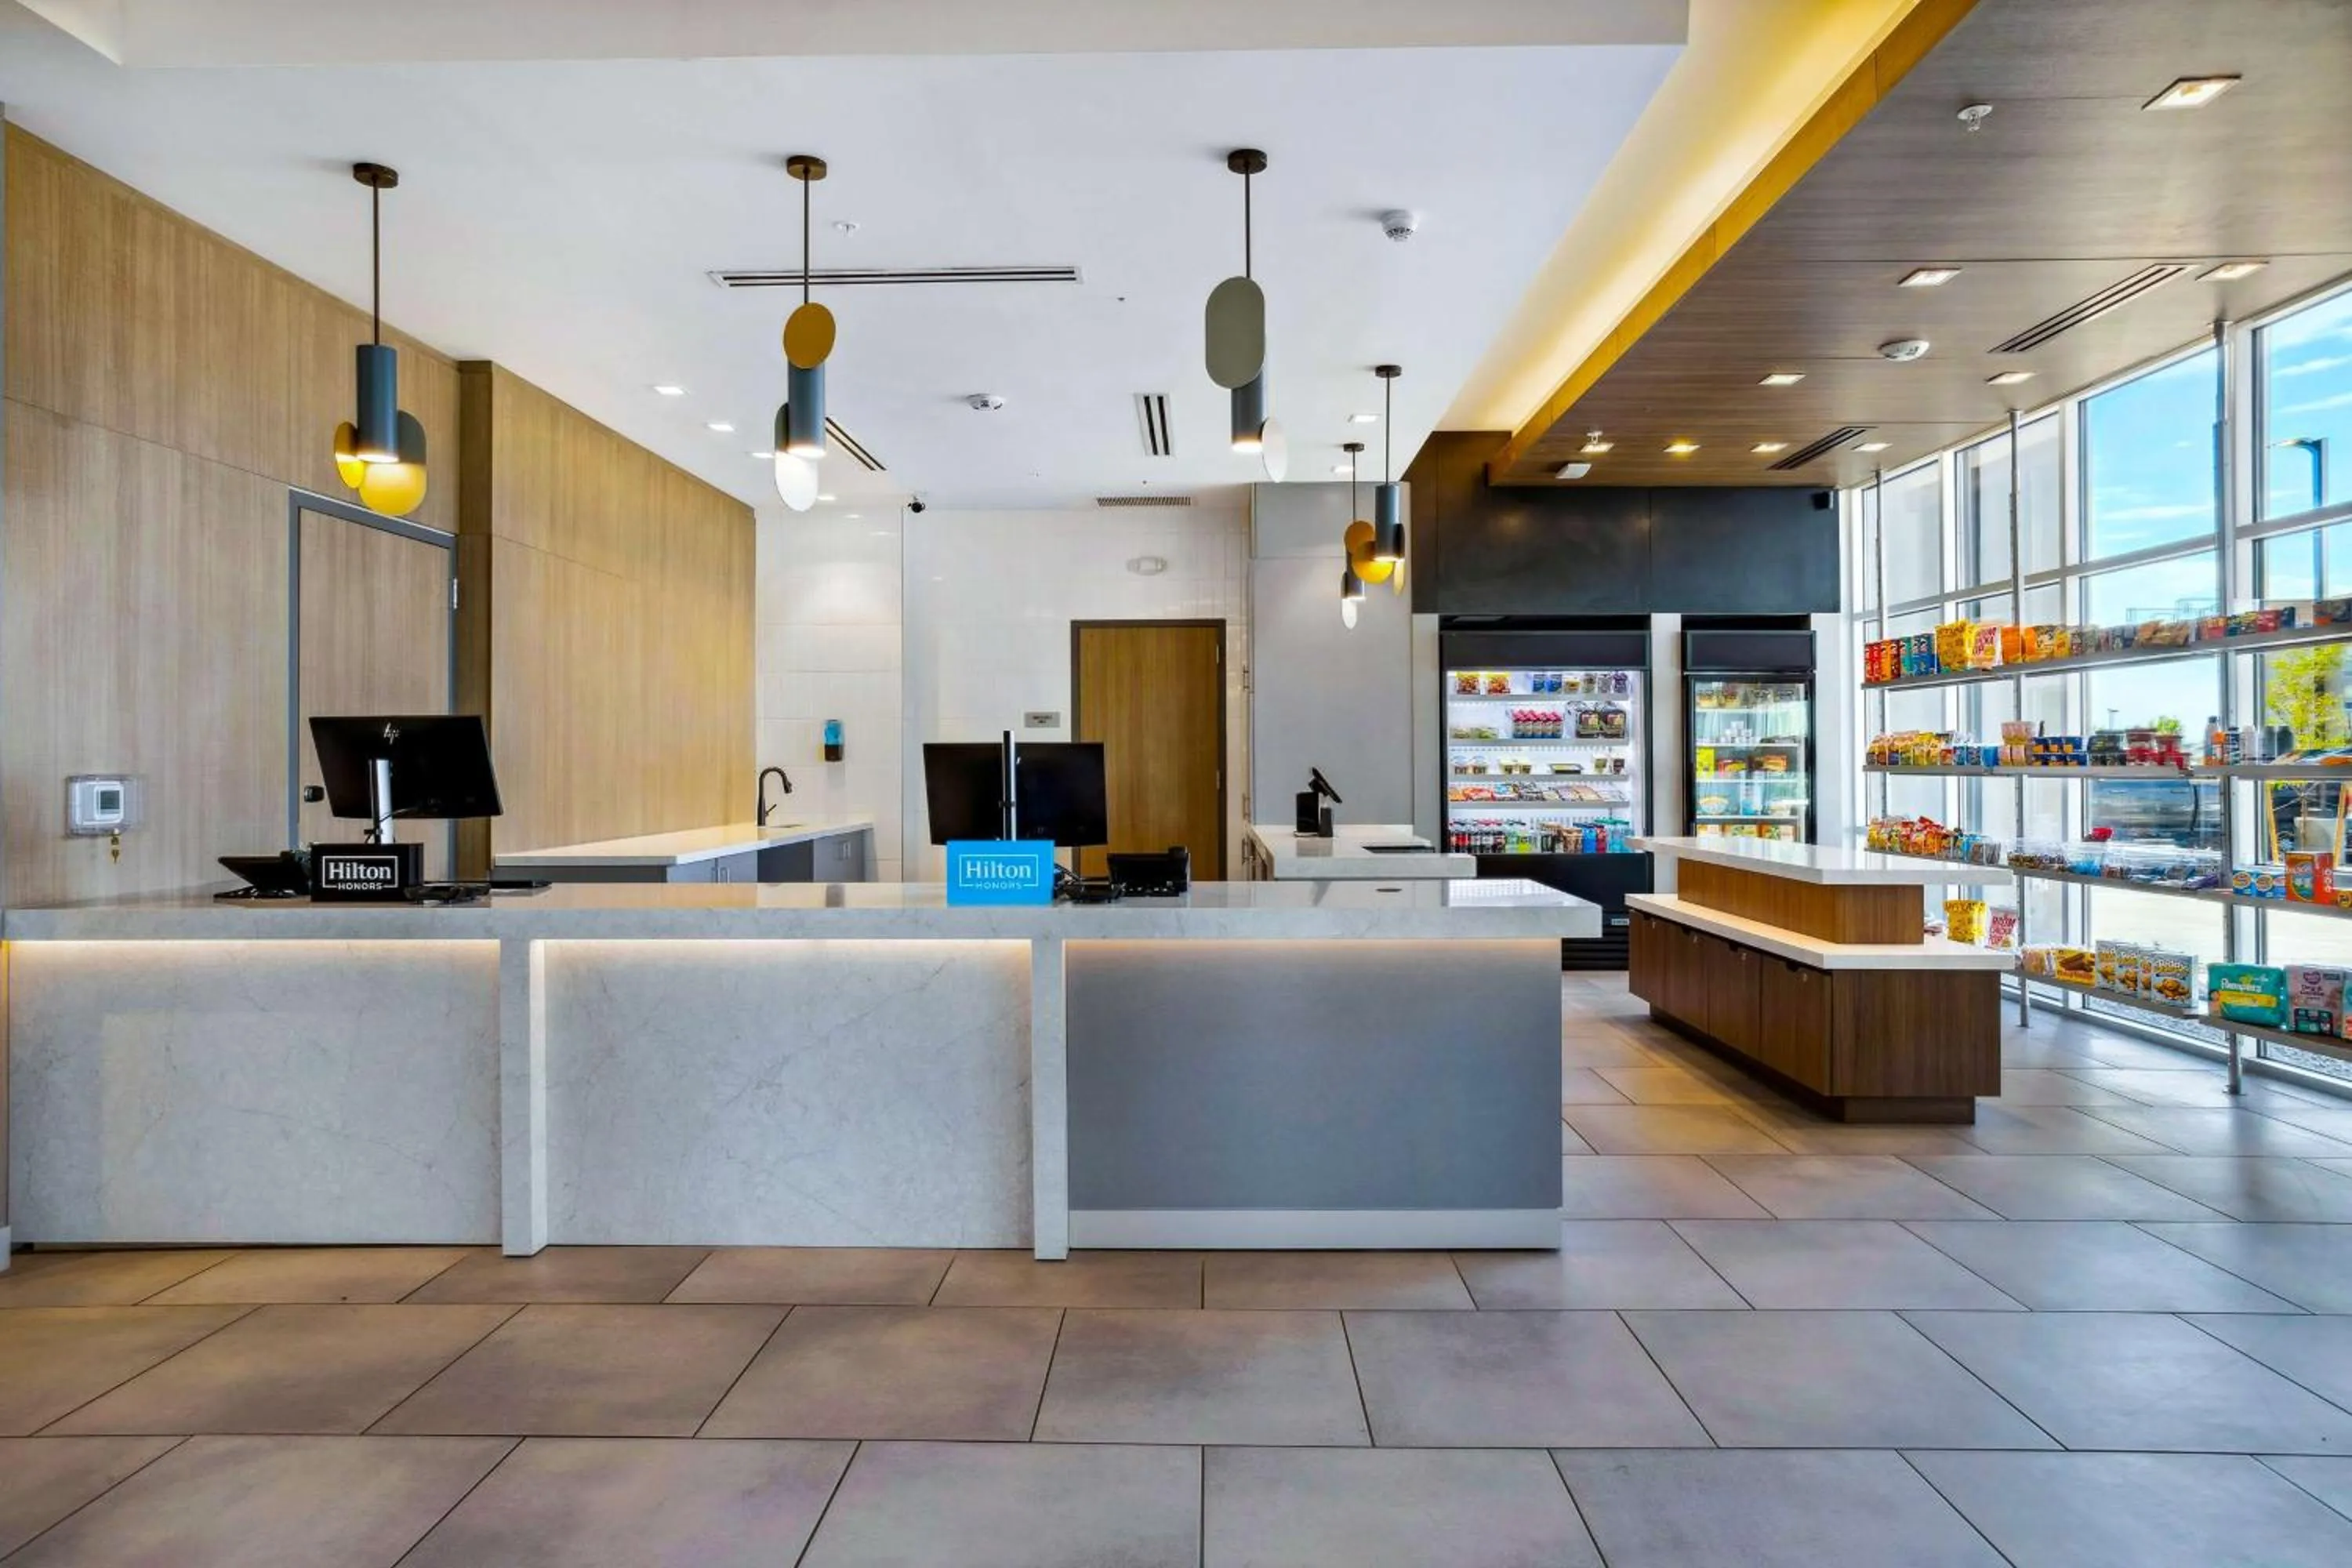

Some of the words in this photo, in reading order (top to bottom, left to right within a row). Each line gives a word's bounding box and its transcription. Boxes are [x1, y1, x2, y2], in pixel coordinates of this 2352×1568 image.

[328, 862, 391, 880] Hilton
[965, 860, 1031, 879] Hilton
[338, 882, 383, 891] HONORS
[976, 880, 1022, 890] HONORS
[2220, 978, 2262, 993] Pampers
